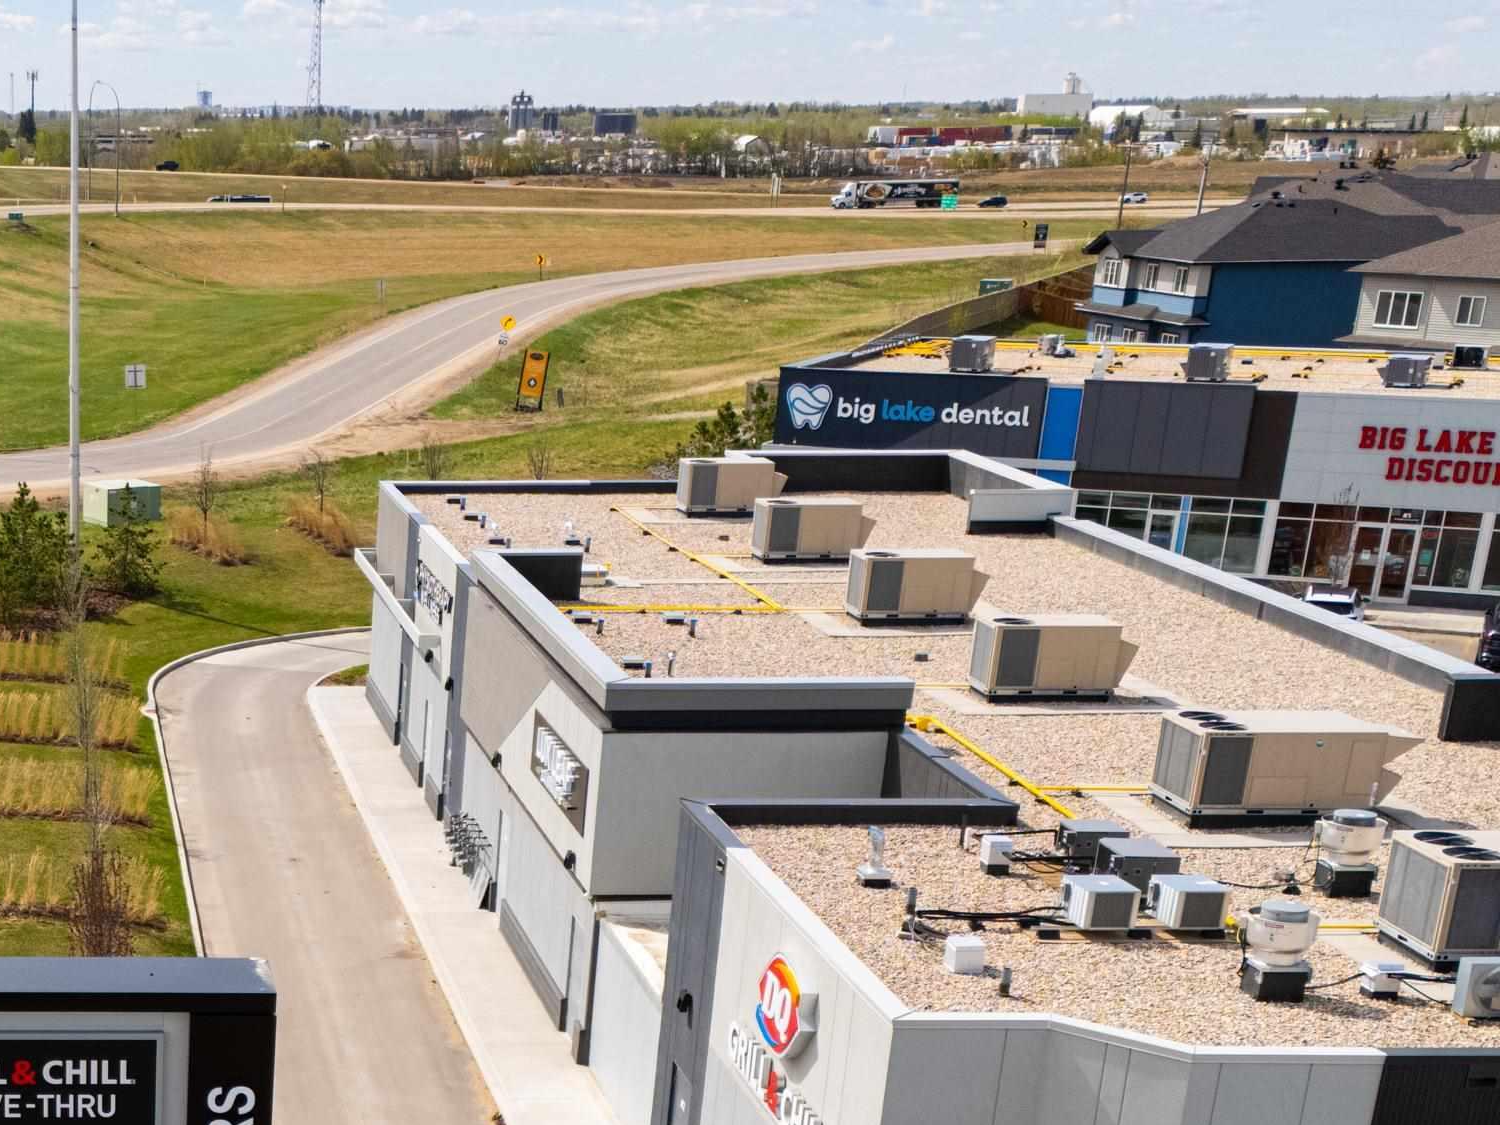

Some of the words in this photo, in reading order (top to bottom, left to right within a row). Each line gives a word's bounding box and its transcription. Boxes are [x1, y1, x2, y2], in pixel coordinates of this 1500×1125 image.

[837, 397, 875, 423] big
[882, 400, 935, 422] lake
[941, 403, 1029, 427] dental
[1359, 426, 1407, 450] BIG
[1416, 428, 1496, 455] LAKE
[11, 1060, 37, 1085] &
[42, 1060, 134, 1085] CHILL
